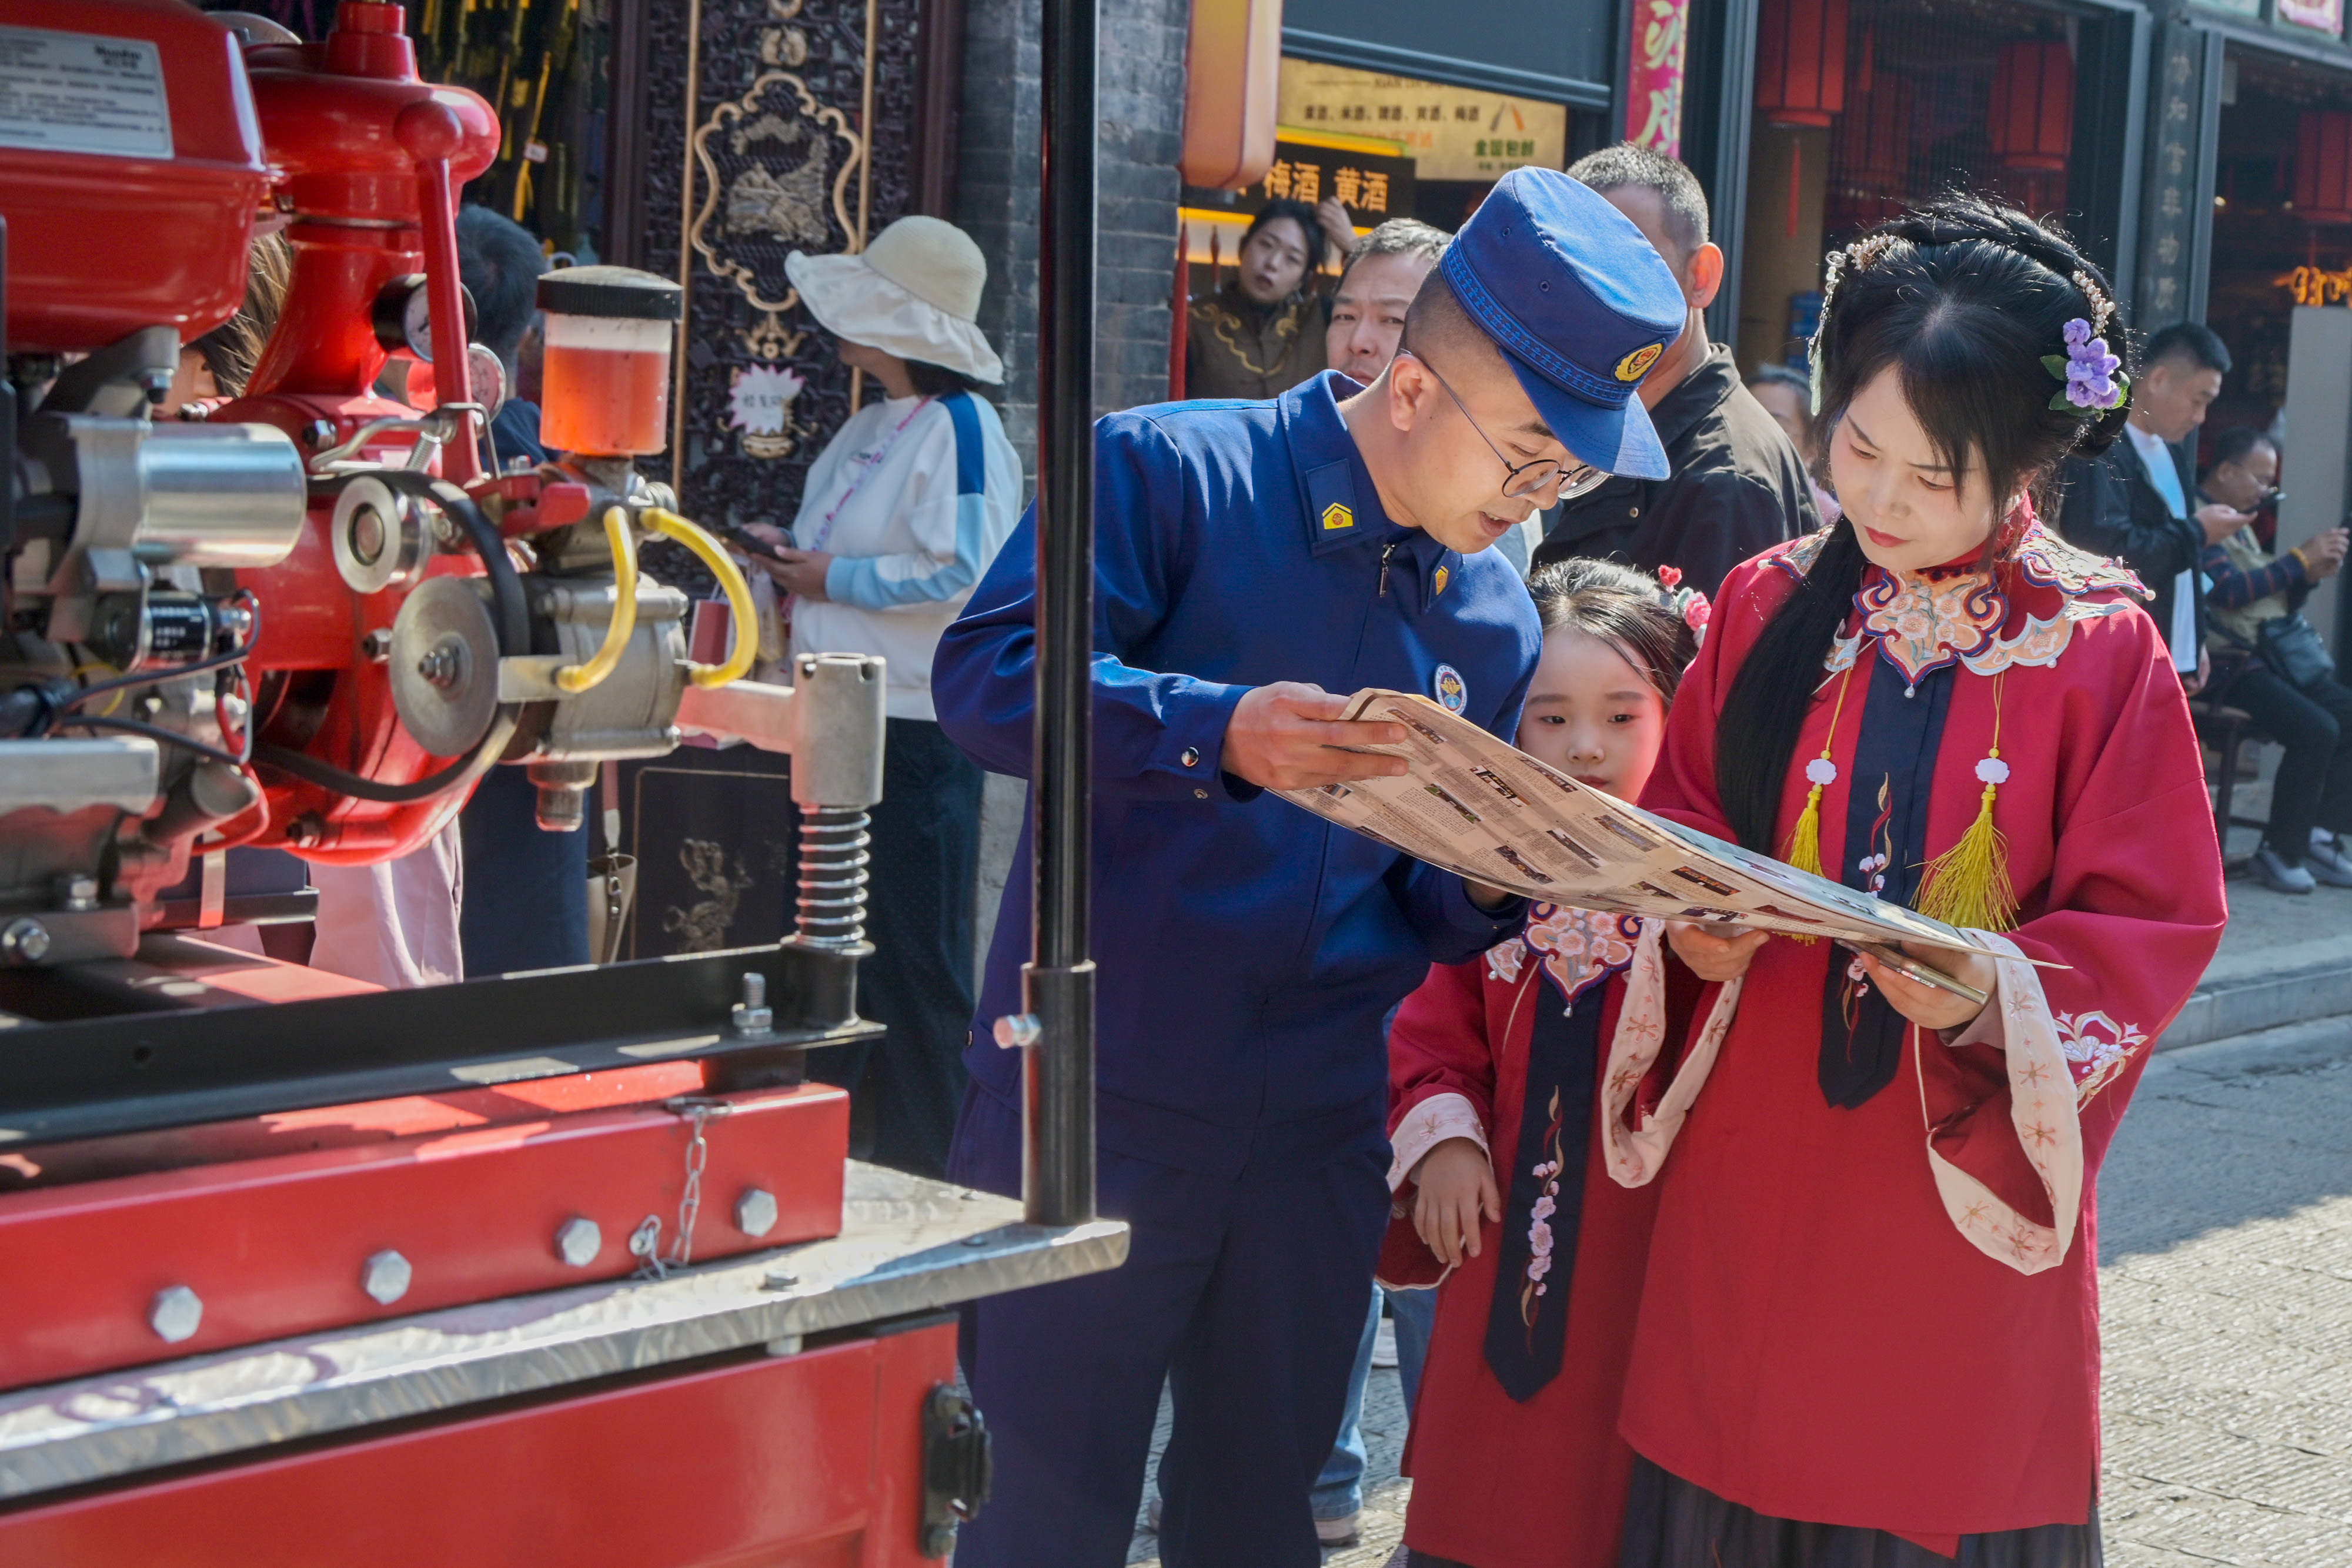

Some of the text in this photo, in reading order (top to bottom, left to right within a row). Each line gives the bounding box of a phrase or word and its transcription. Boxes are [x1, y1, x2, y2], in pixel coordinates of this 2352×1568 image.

[1475, 139, 1534, 157] 全国包邮
[1264, 159, 1388, 212] 梅酒 黄酒
